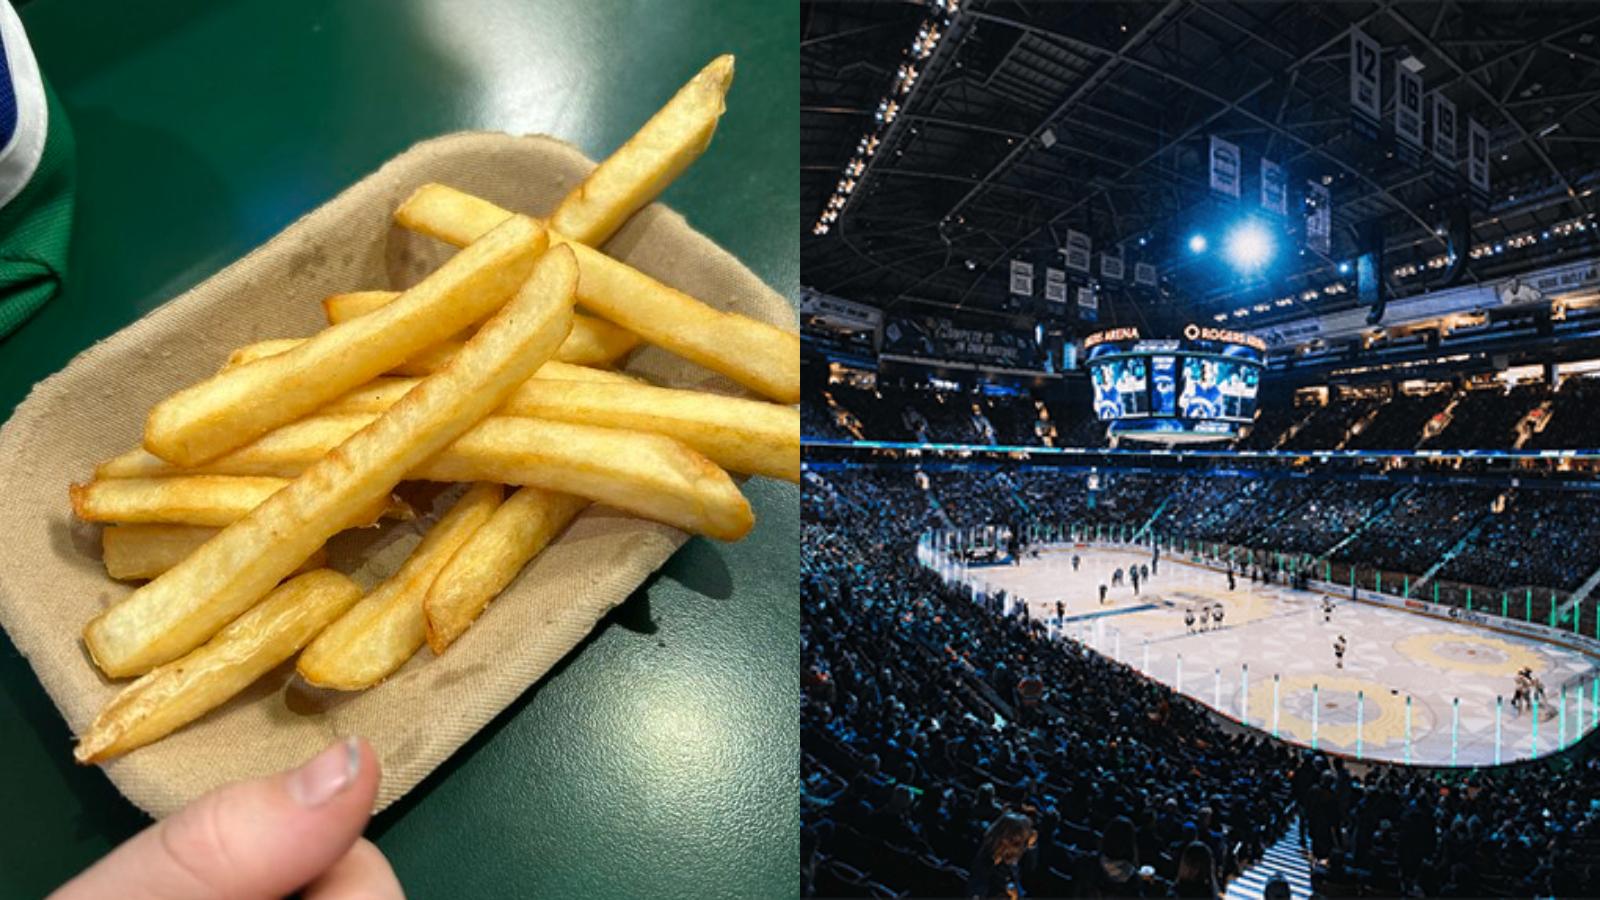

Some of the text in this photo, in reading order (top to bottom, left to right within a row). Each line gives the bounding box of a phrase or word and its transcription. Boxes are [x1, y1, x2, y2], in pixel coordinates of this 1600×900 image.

[1356, 39, 1376, 83] 12
[1400, 73, 1418, 113] 16
[1104, 327, 1140, 341] ARENA
[1201, 327, 1246, 345] ROGERS
